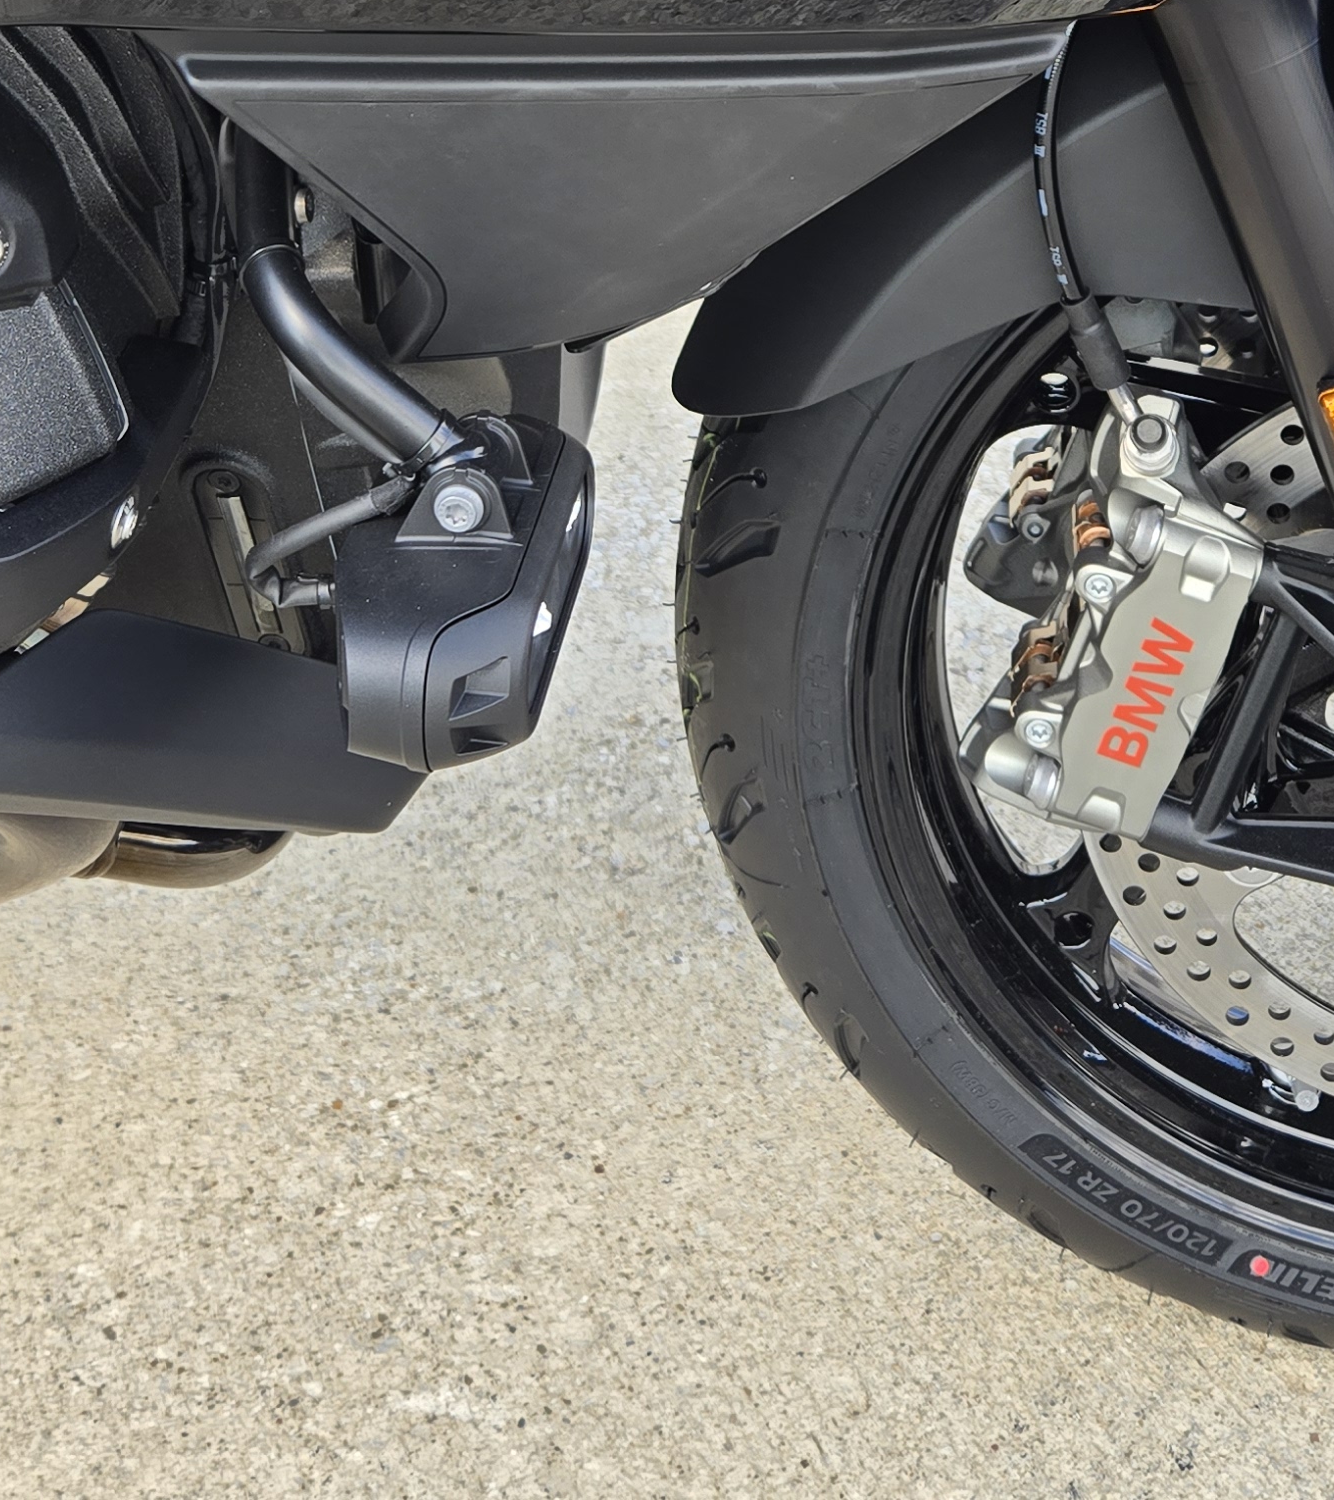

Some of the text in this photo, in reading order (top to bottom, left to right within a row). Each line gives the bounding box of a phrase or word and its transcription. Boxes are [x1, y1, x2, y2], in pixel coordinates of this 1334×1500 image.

[1096, 616, 1195, 769] BMW
[1042, 1152, 1077, 1175] 17
[1076, 1171, 1120, 1203] ZR
[1120, 1198, 1217, 1257] 120/70
